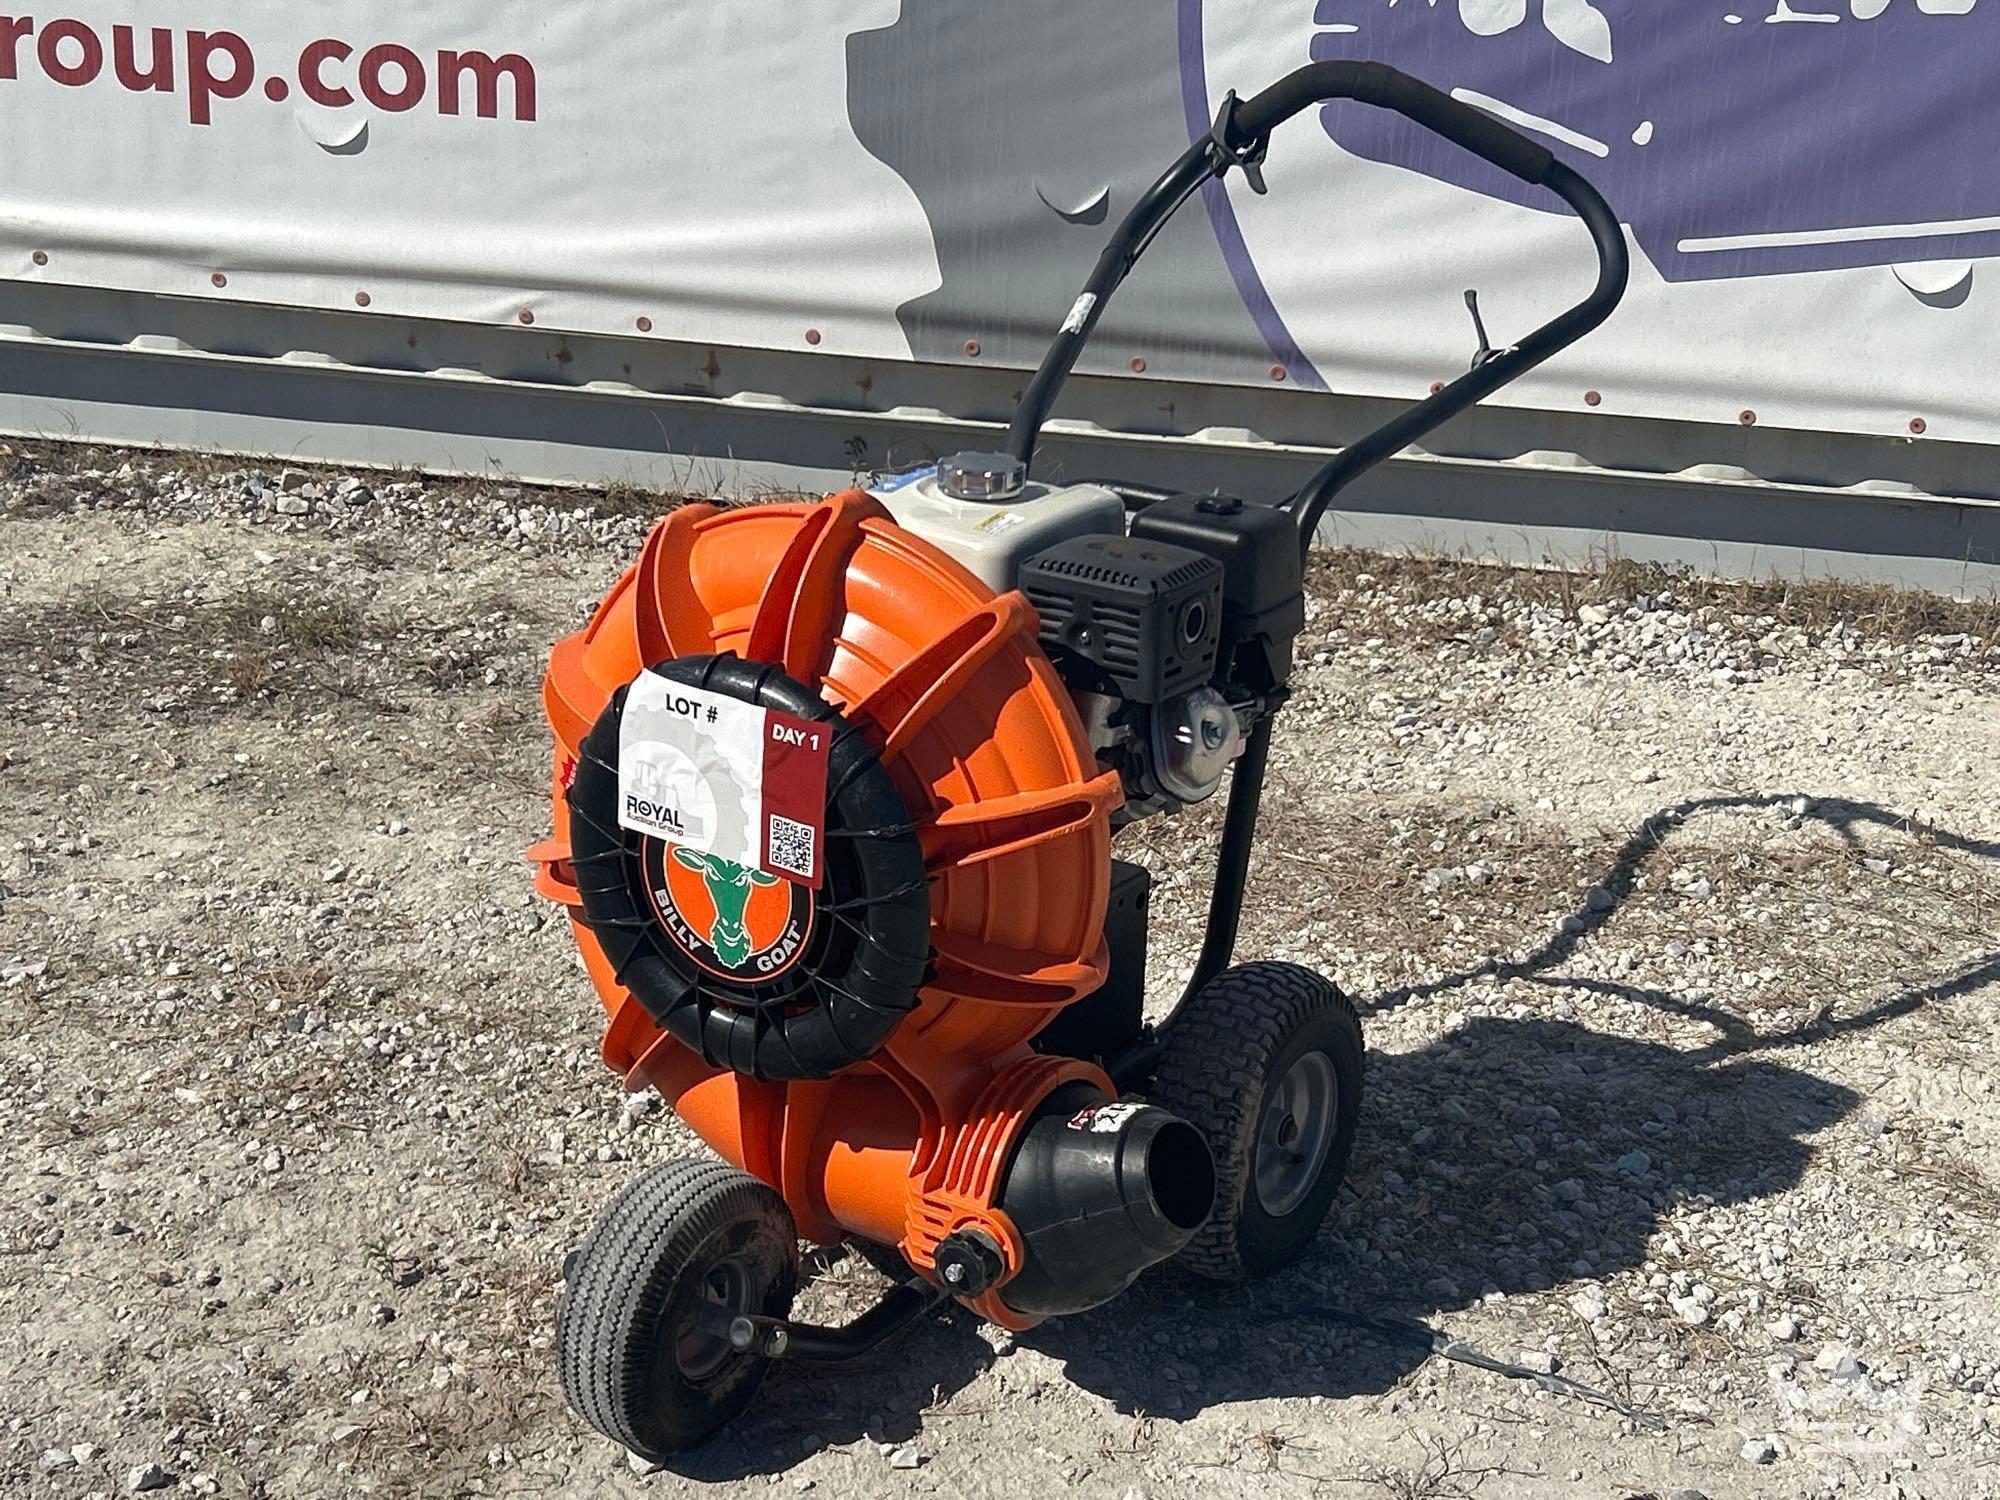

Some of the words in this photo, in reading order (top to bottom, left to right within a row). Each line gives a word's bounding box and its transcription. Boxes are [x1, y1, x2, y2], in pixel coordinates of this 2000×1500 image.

[665, 693, 701, 720] LOT
[706, 706, 719, 723] #
[772, 723, 806, 747] DAY
[809, 734, 819, 750] 1
[627, 794, 684, 828] ROYAL
[655, 889, 702, 951] BILLY
[757, 923, 801, 972] GOAT
